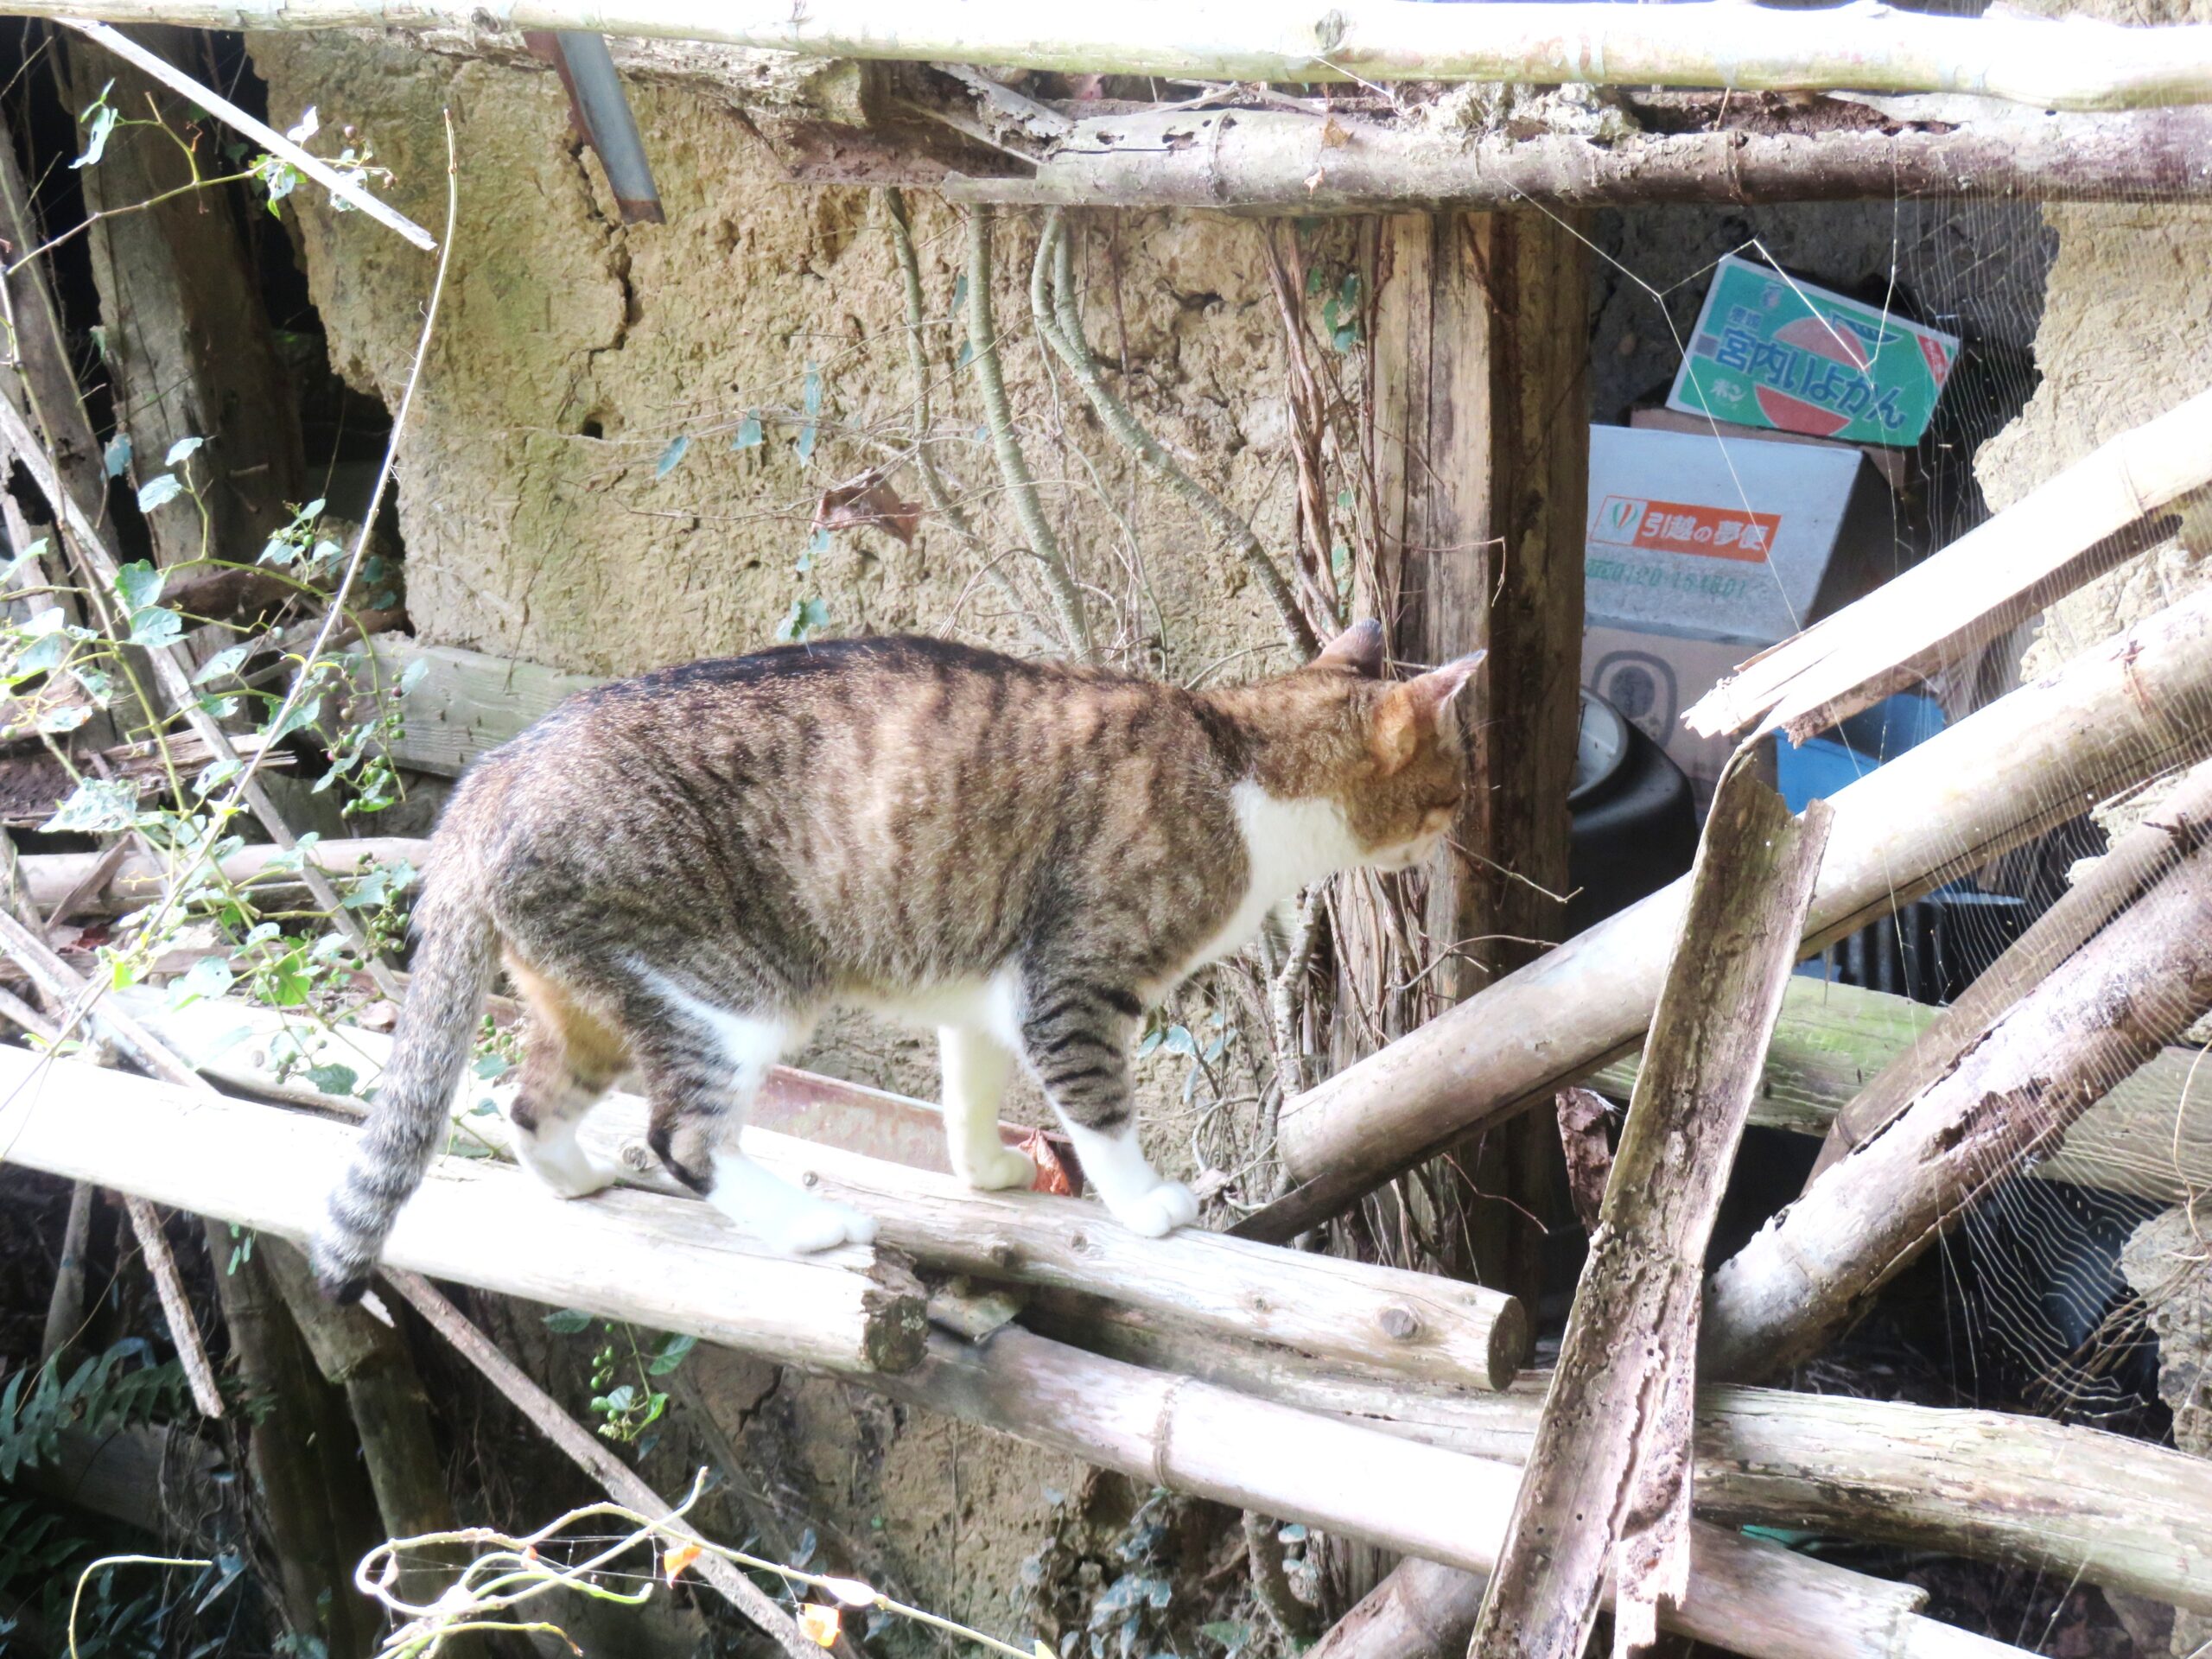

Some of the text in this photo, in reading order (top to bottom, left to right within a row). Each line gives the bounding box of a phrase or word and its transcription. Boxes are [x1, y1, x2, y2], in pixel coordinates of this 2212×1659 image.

[1714, 327, 1906, 429] 宮内いよかん
[1641, 512, 1770, 551] 引越の夢便
